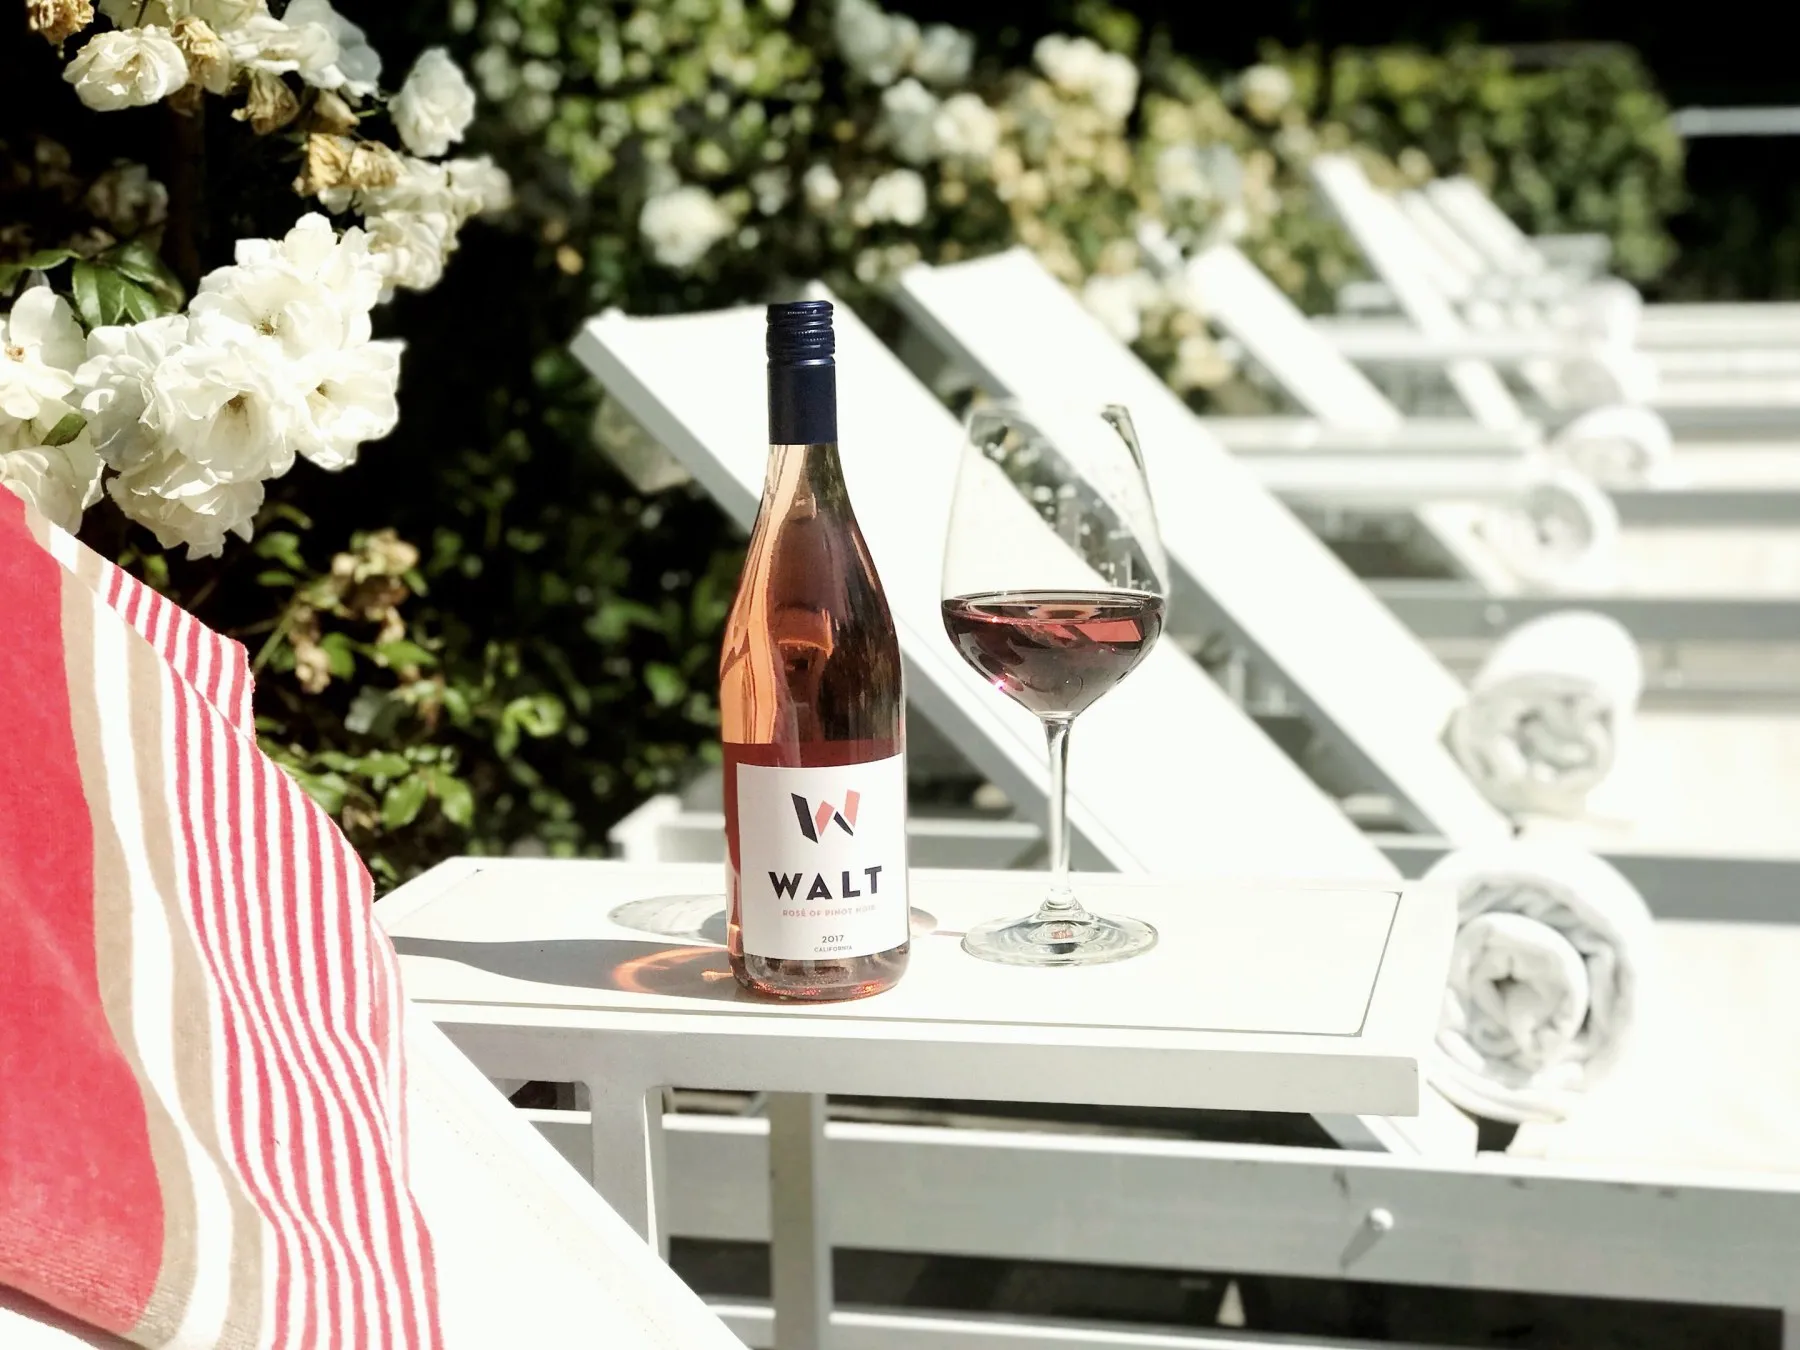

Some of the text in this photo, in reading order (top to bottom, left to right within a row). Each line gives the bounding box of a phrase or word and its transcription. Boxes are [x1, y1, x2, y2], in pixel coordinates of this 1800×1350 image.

[791, 789, 861, 844] W
[768, 865, 882, 901] WALT
[782, 908, 806, 917] ROSÉ
[809, 909, 821, 917] OF
[825, 907, 852, 916] PINOT
[821, 934, 845, 944] 2017
[814, 945, 853, 953] CALIFORNIA
